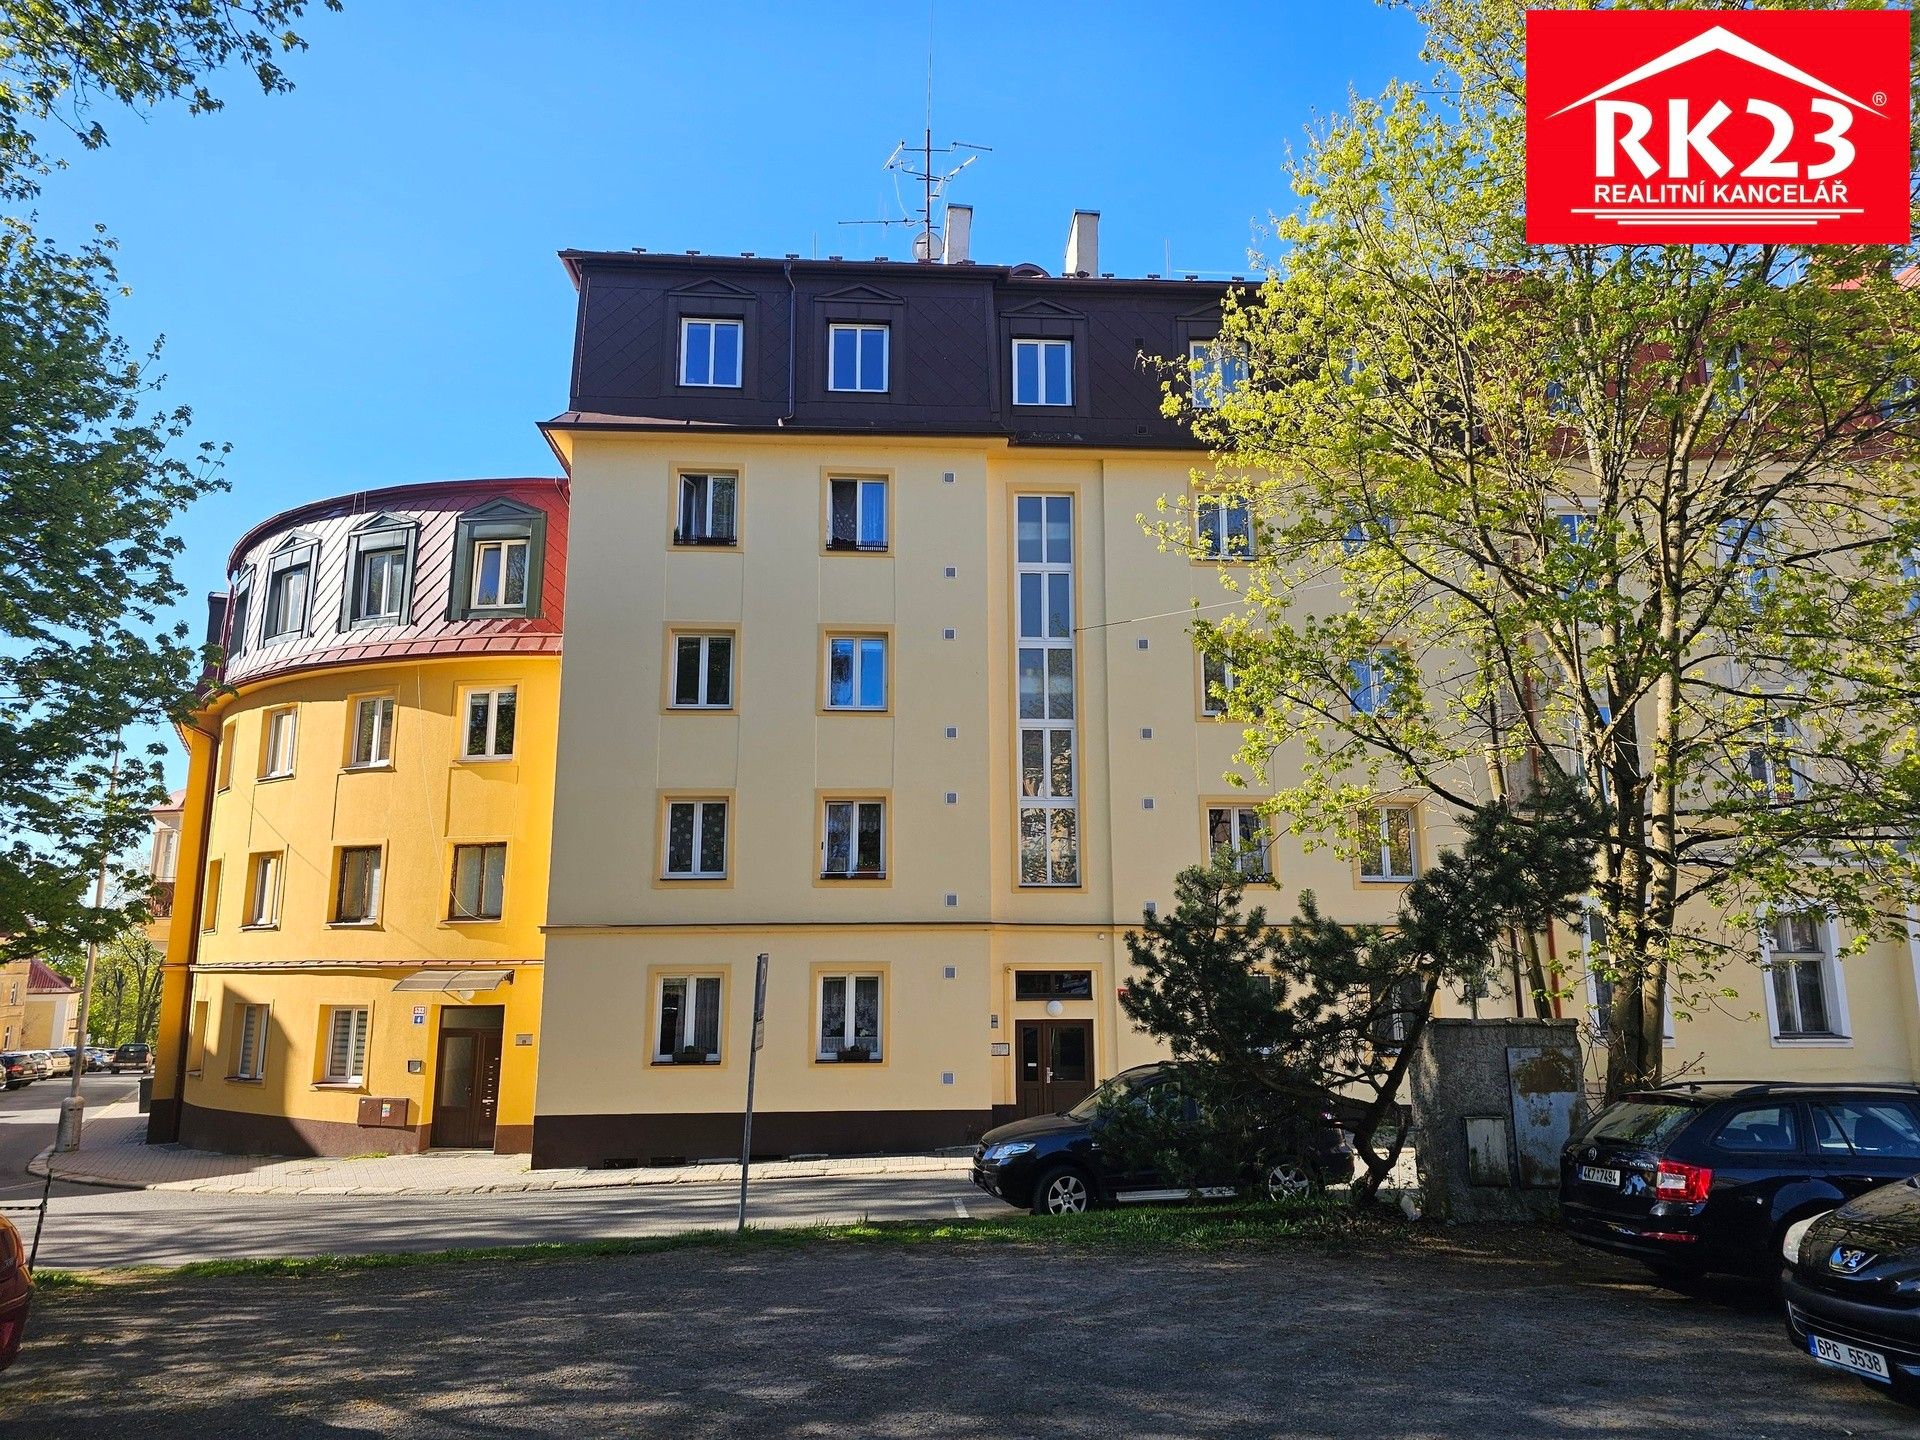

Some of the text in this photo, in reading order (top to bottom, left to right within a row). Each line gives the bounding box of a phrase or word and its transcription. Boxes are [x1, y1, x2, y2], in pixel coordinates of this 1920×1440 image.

[1600, 1169, 1617, 1184] 7494
[1817, 1339, 1882, 1373] 6P6 5538
